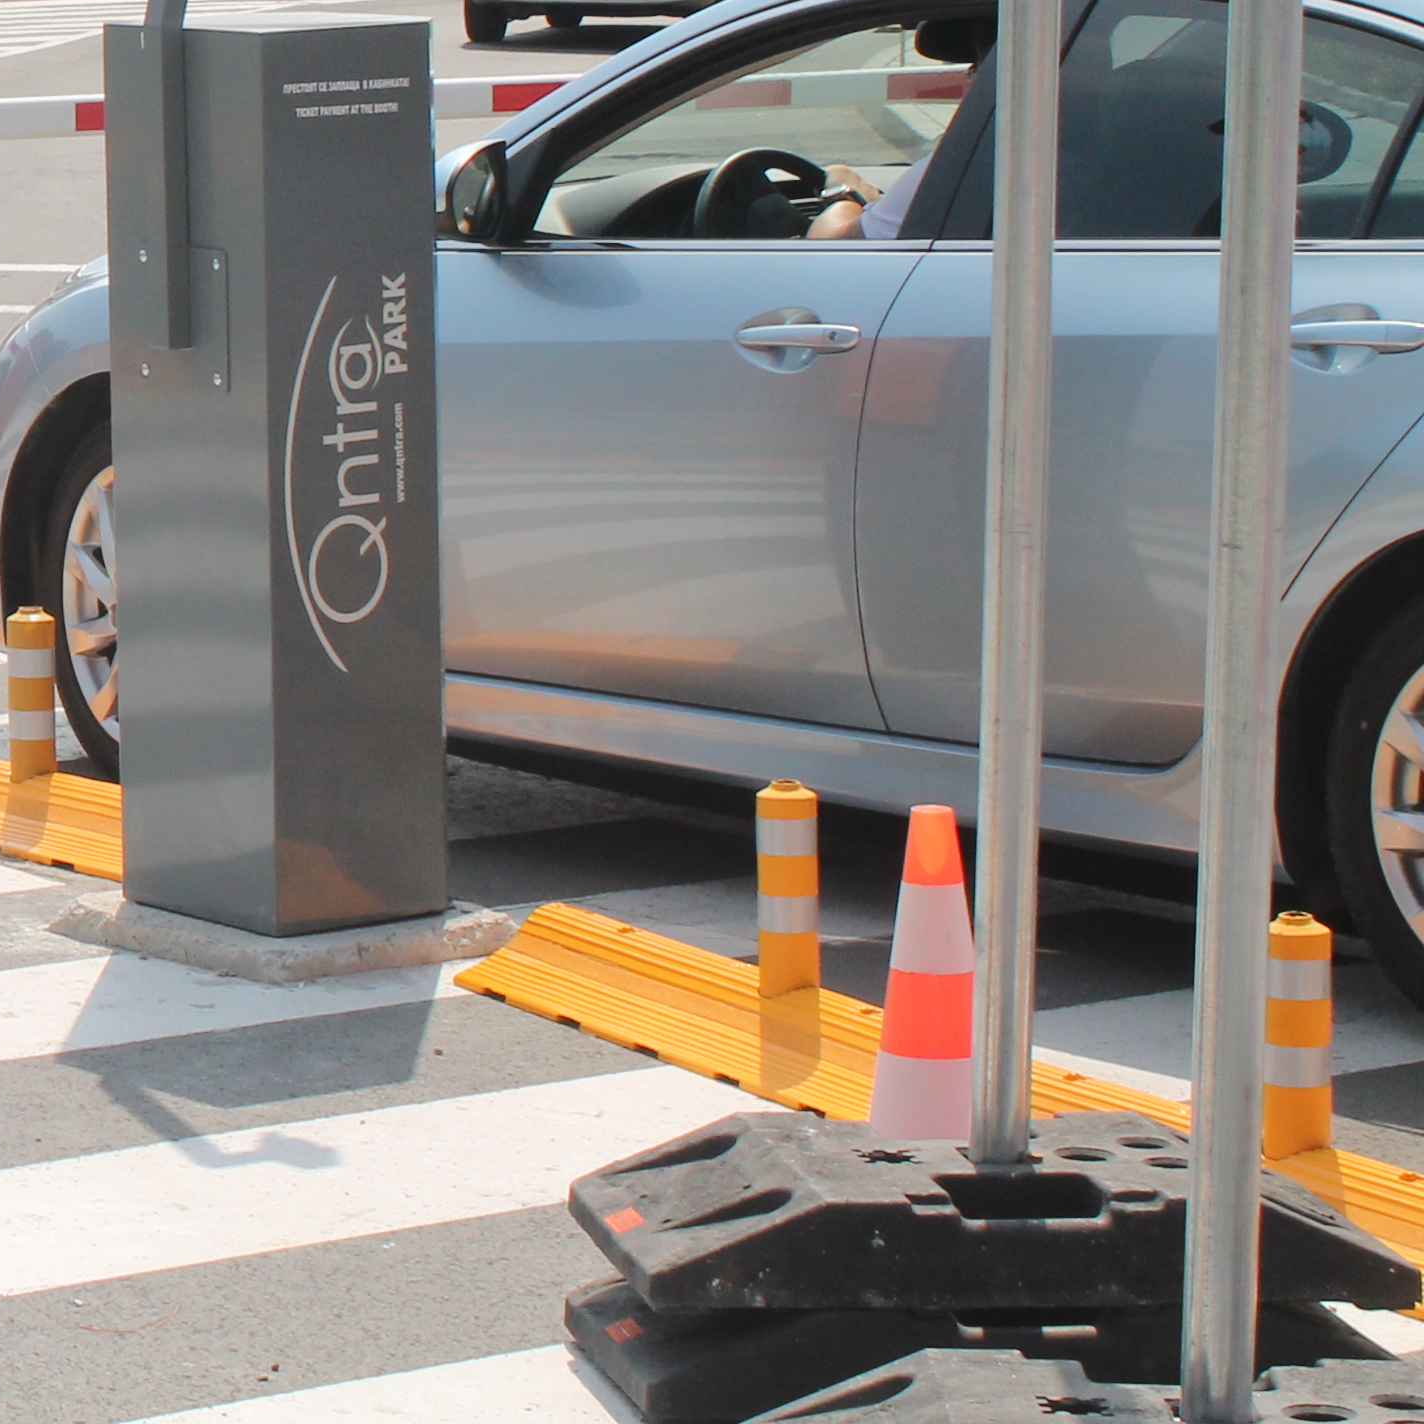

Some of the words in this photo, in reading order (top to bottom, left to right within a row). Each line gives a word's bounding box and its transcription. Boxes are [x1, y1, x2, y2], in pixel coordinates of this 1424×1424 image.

[296, 106, 319, 118] TICKET
[320, 105, 350, 116] PAYMENT
[350, 104, 360, 115] AT
[360, 103, 373, 114] THE
[384, 271, 408, 375] PARK
[308, 331, 389, 624] Qntra
[393, 401, 406, 504] www.qntra.com
